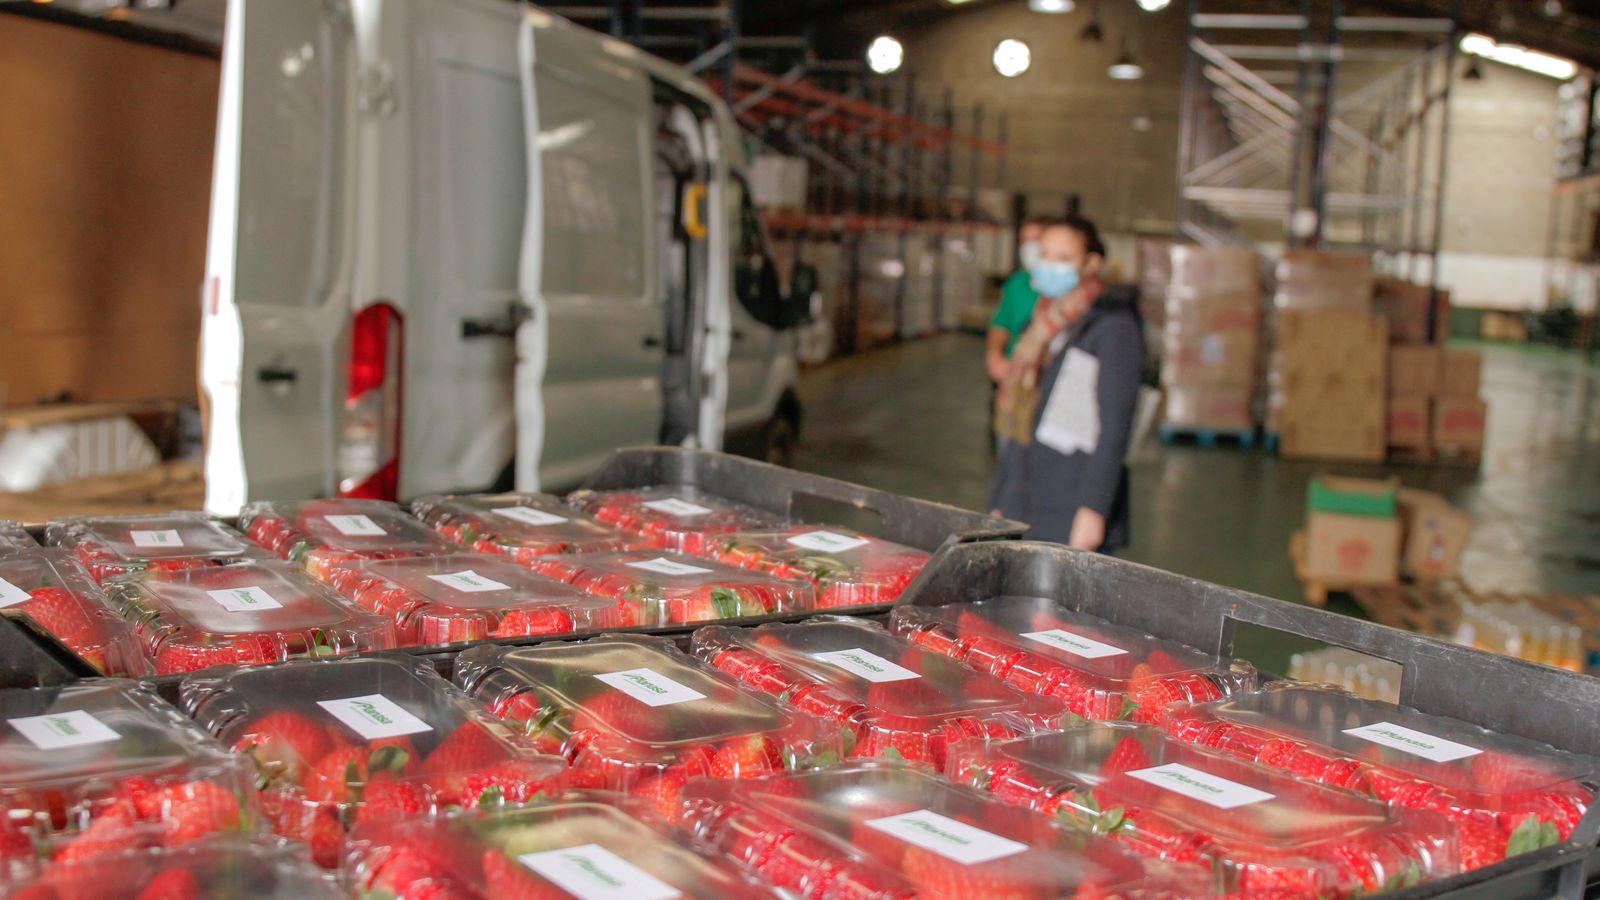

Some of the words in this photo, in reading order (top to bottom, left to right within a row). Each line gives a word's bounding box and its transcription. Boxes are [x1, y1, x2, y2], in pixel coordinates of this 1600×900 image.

[847, 655, 884, 672] Planasa
[630, 675, 668, 694] Planasa
[358, 701, 392, 725] Planasa
[1377, 730, 1434, 749] Planasa
[1165, 772, 1224, 793] Planasa
